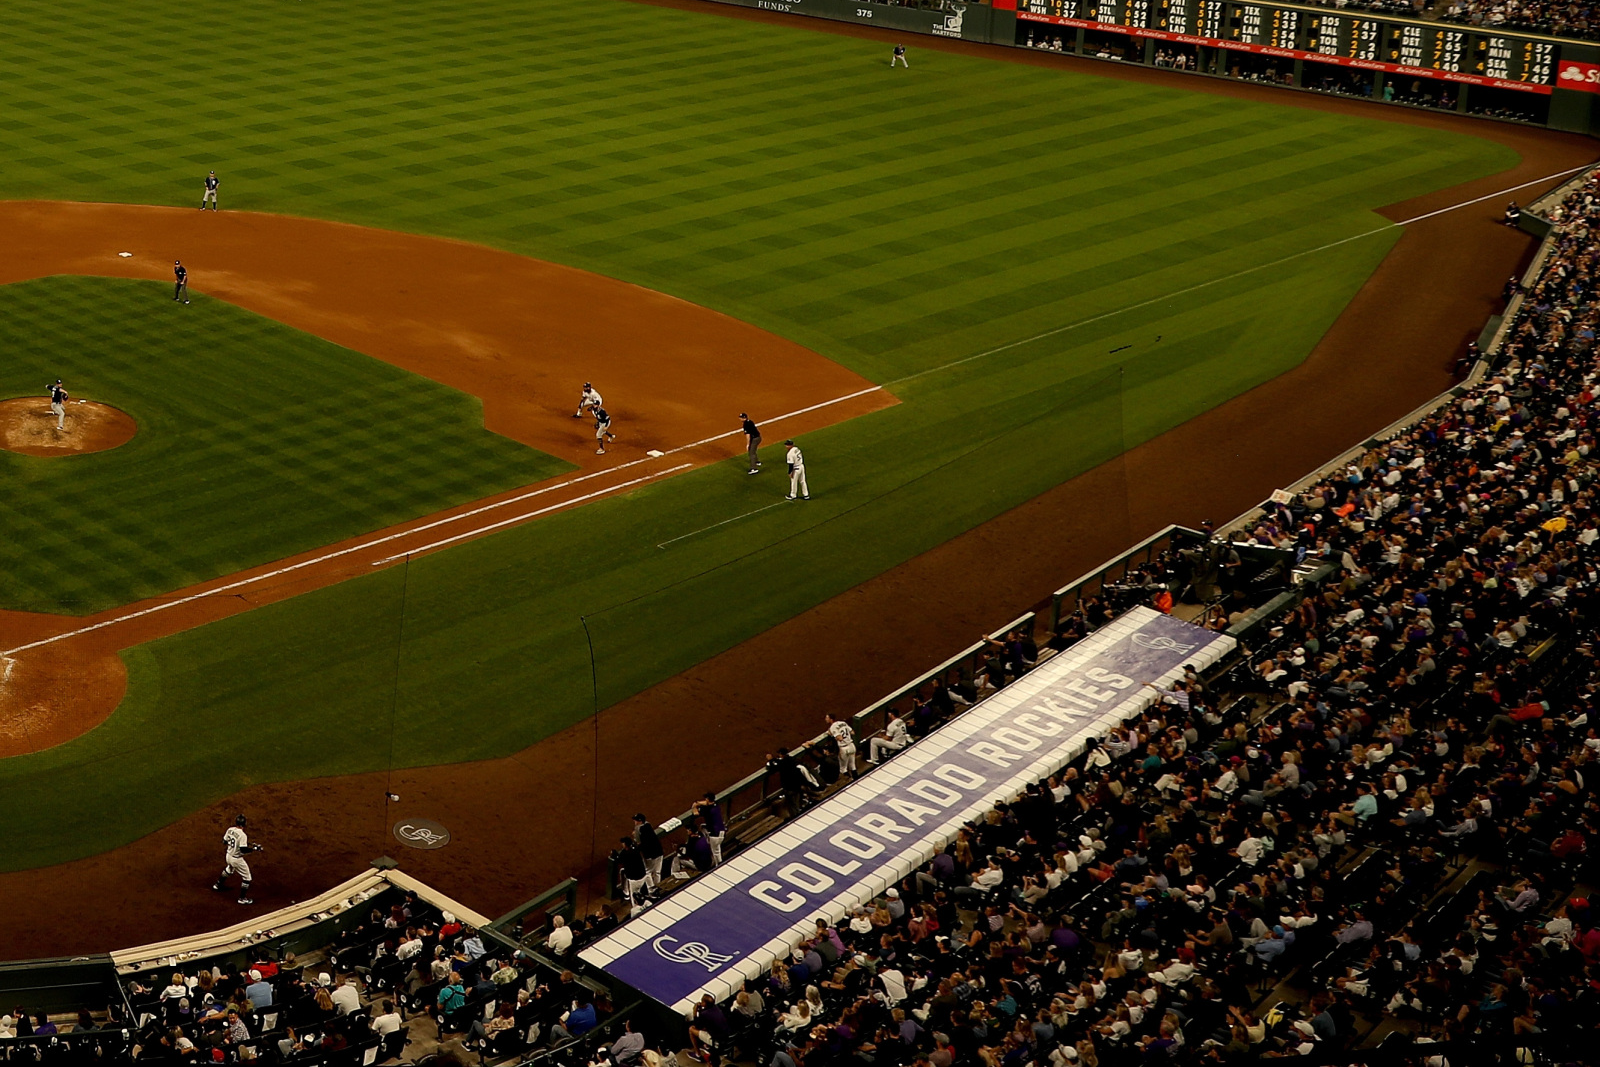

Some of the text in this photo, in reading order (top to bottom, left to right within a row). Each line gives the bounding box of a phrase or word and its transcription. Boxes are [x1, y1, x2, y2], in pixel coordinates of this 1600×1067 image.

[758, 0, 790, 12] FUNDS
[1030, 5, 1047, 15] WSH
[1099, 6, 1112, 15] STL
[1170, 6, 1185, 15] ATL
[1244, 6, 1260, 16] TEX
[856, 9, 872, 18] 375
[1097, 15, 1115, 24] NYM
[1169, 15, 1187, 25] CHC
[1243, 15, 1260, 25] CIN
[1321, 16, 1340, 26] BOS
[932, 23, 943, 31] THE
[1169, 24, 1186, 34] LAD
[1242, 25, 1259, 35] LAA
[1320, 25, 1338, 36] BAL
[1403, 26, 1421, 37] CLE
[932, 28, 962, 38] HARTFORD
[1241, 34, 1252, 43] TB
[1320, 35, 1338, 46] TOR
[1402, 36, 1420, 46] DET
[1489, 37, 1505, 48] KC
[1319, 45, 1337, 55] HOU
[1401, 46, 1423, 57] NYY
[1488, 47, 1511, 59] MIN
[1400, 56, 1422, 67] CHW
[1487, 58, 1507, 70] SEA
[1486, 68, 1509, 80] OAK
[748, 665, 1136, 913] COLORADO ROCKIES
